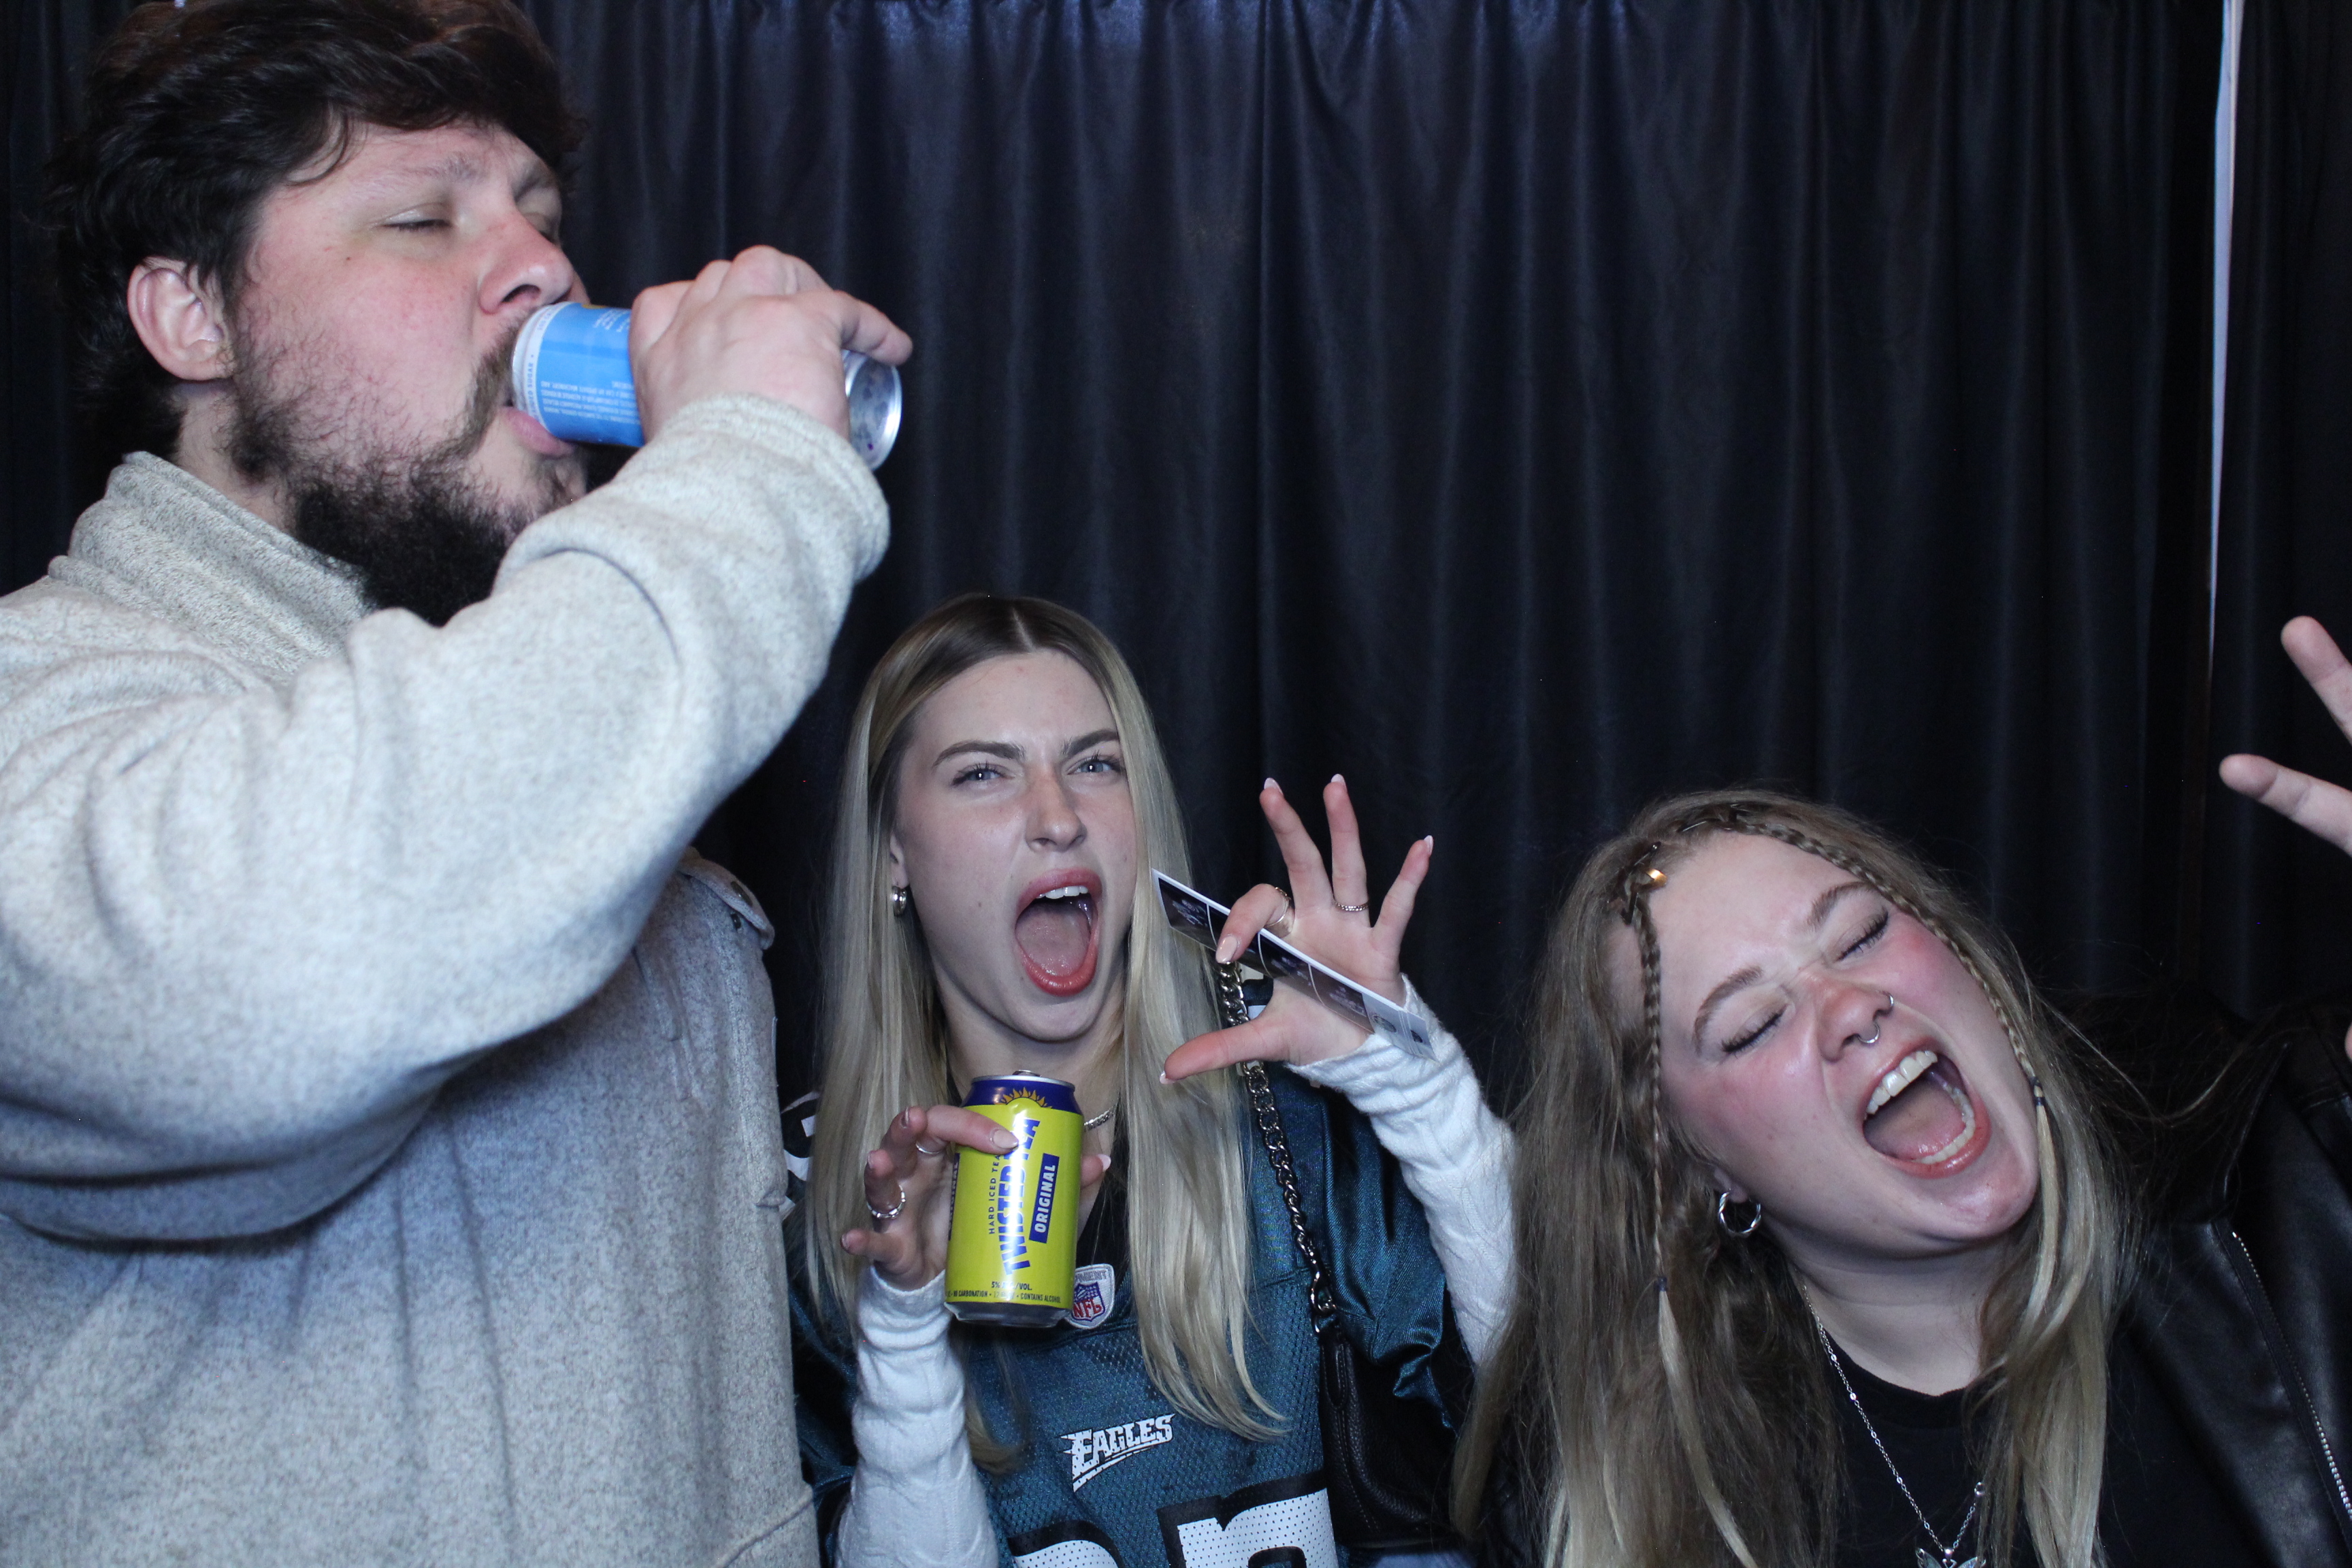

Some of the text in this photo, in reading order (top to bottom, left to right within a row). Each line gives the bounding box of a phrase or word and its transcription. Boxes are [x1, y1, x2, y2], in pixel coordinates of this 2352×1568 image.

[992, 1154, 1001, 1173] TEA
[988, 1177, 997, 1201] ICED
[1034, 1164, 1056, 1233] ORIGINAL
[997, 1165, 1030, 1275] TWISTED
[959, 1290, 987, 1298] CARBONATION
[1021, 1292, 1043, 1301] CONTAINS
[1044, 1294, 1062, 1303] ALCOHOL
[1073, 1298, 1102, 1318] NFL
[1059, 1413, 1175, 1482] EAGLES
